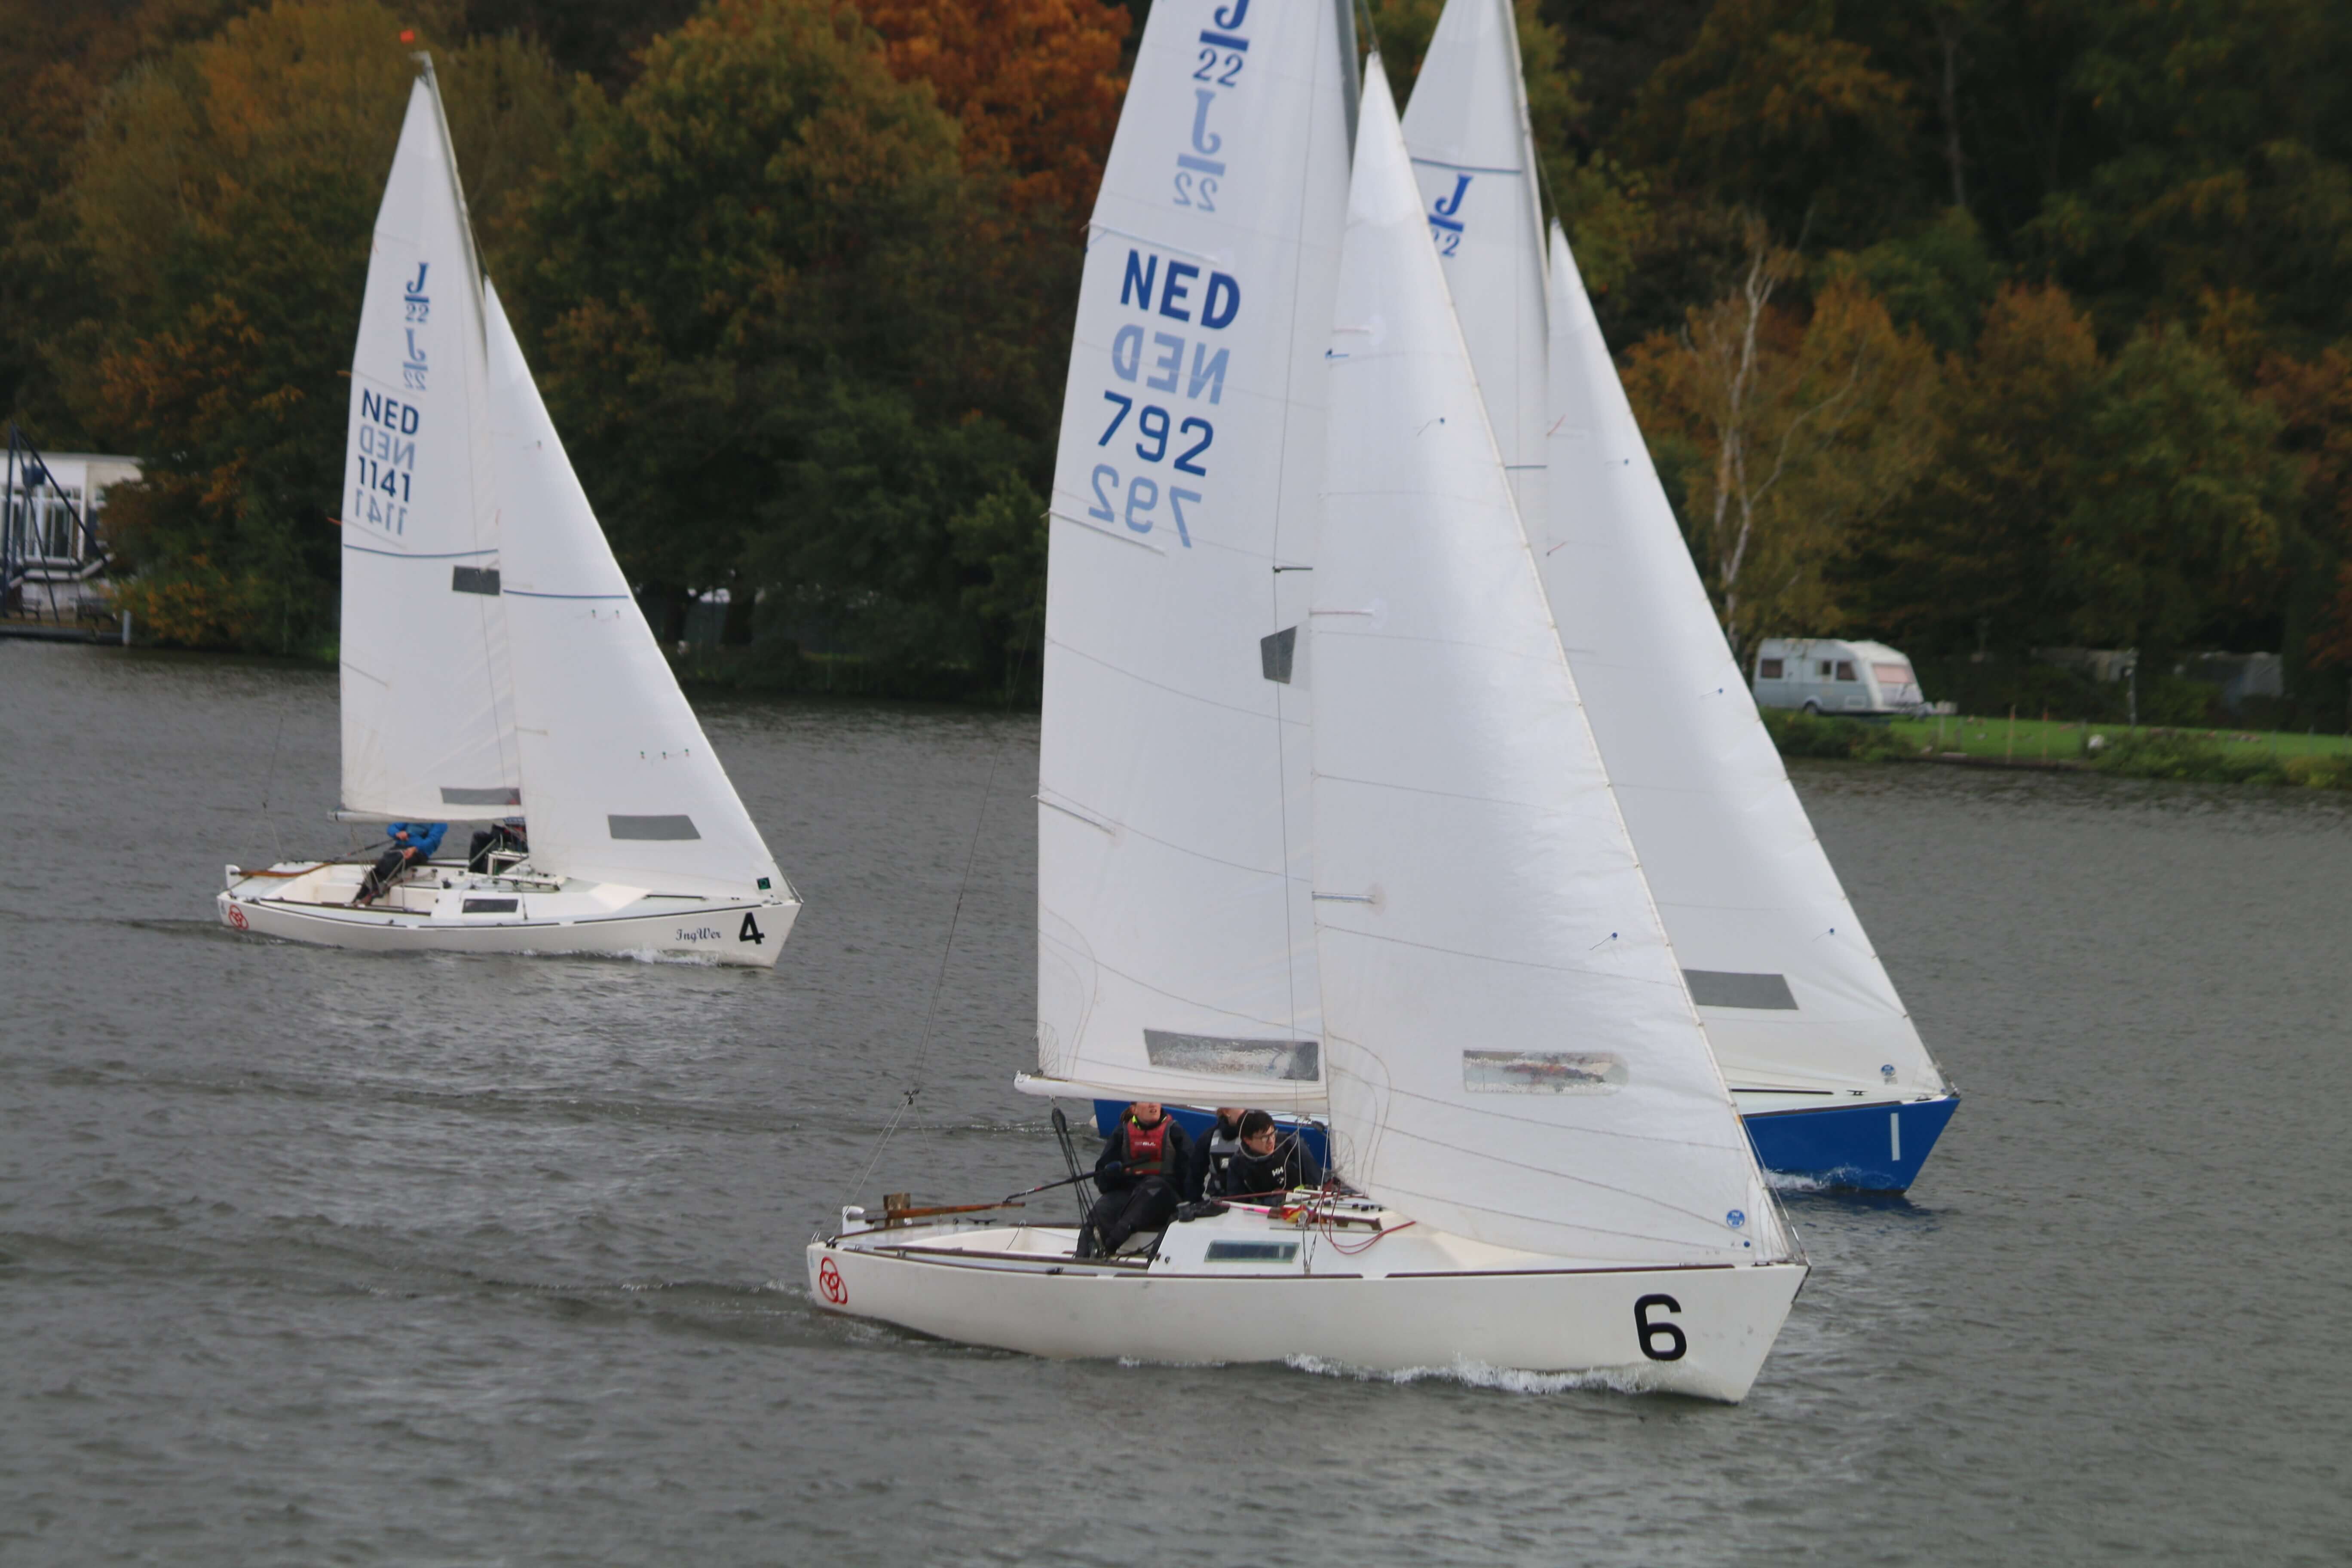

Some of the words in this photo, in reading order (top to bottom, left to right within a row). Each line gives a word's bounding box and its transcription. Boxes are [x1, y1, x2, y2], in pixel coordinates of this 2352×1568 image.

[1192, 47, 1244, 88] 22
[1434, 174, 1474, 216] J
[406, 262, 429, 294] J
[1120, 248, 1241, 330] NED
[405, 302, 429, 324] 22
[361, 387, 420, 436] NED
[1097, 390, 1215, 478] 792
[358, 455, 411, 503] 1141
[738, 912, 766, 945] 4
[1890, 1112, 1901, 1161] 1
[1634, 1293, 1687, 1363] 6
